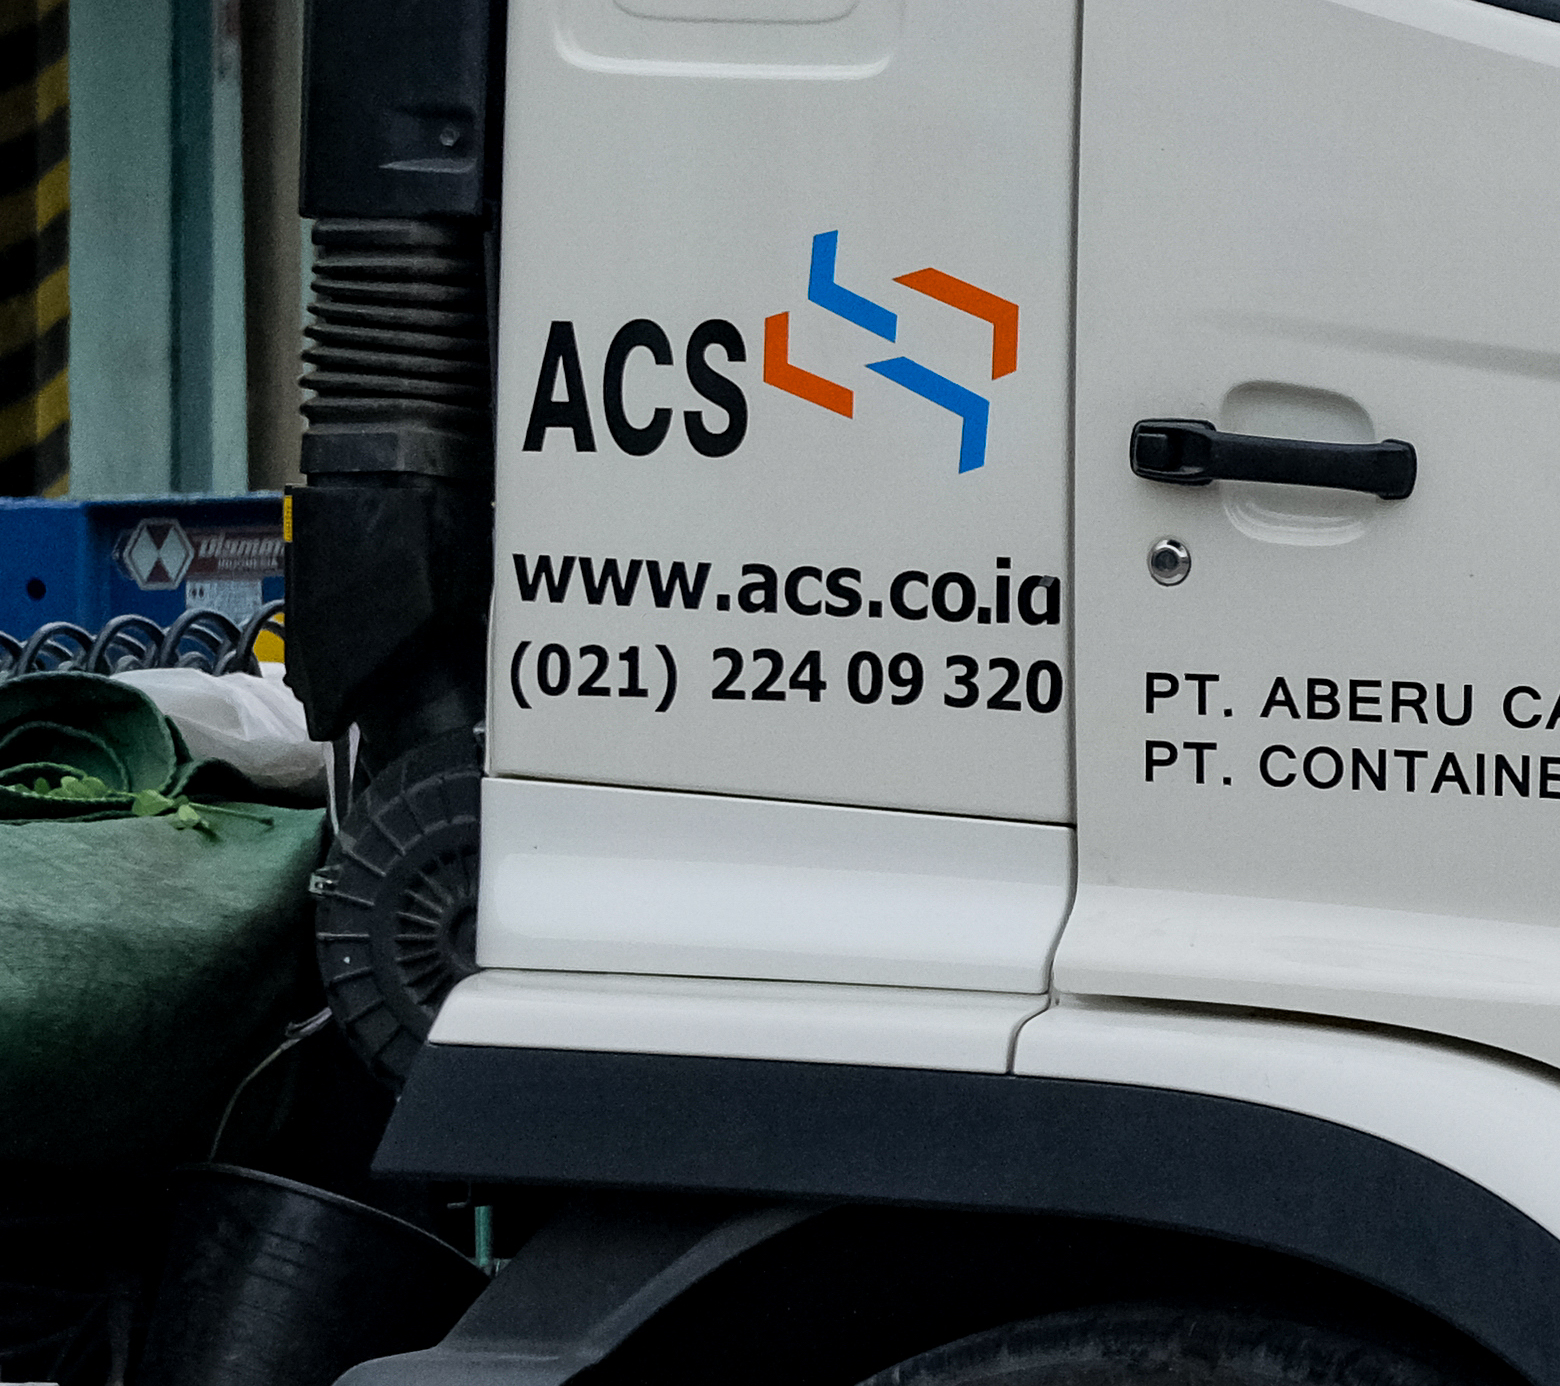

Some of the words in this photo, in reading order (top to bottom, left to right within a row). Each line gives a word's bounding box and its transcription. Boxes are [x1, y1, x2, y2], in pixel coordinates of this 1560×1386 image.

[522, 319, 747, 457] ACS
[511, 641, 677, 713] (021)
[712, 648, 826, 703] 224
[848, 651, 923, 706] 09
[944, 655, 1062, 714] 320
[1146, 672, 1232, 717] PT.
[1260, 677, 1473, 727] ABERU
[1146, 740, 1231, 786] PT.
